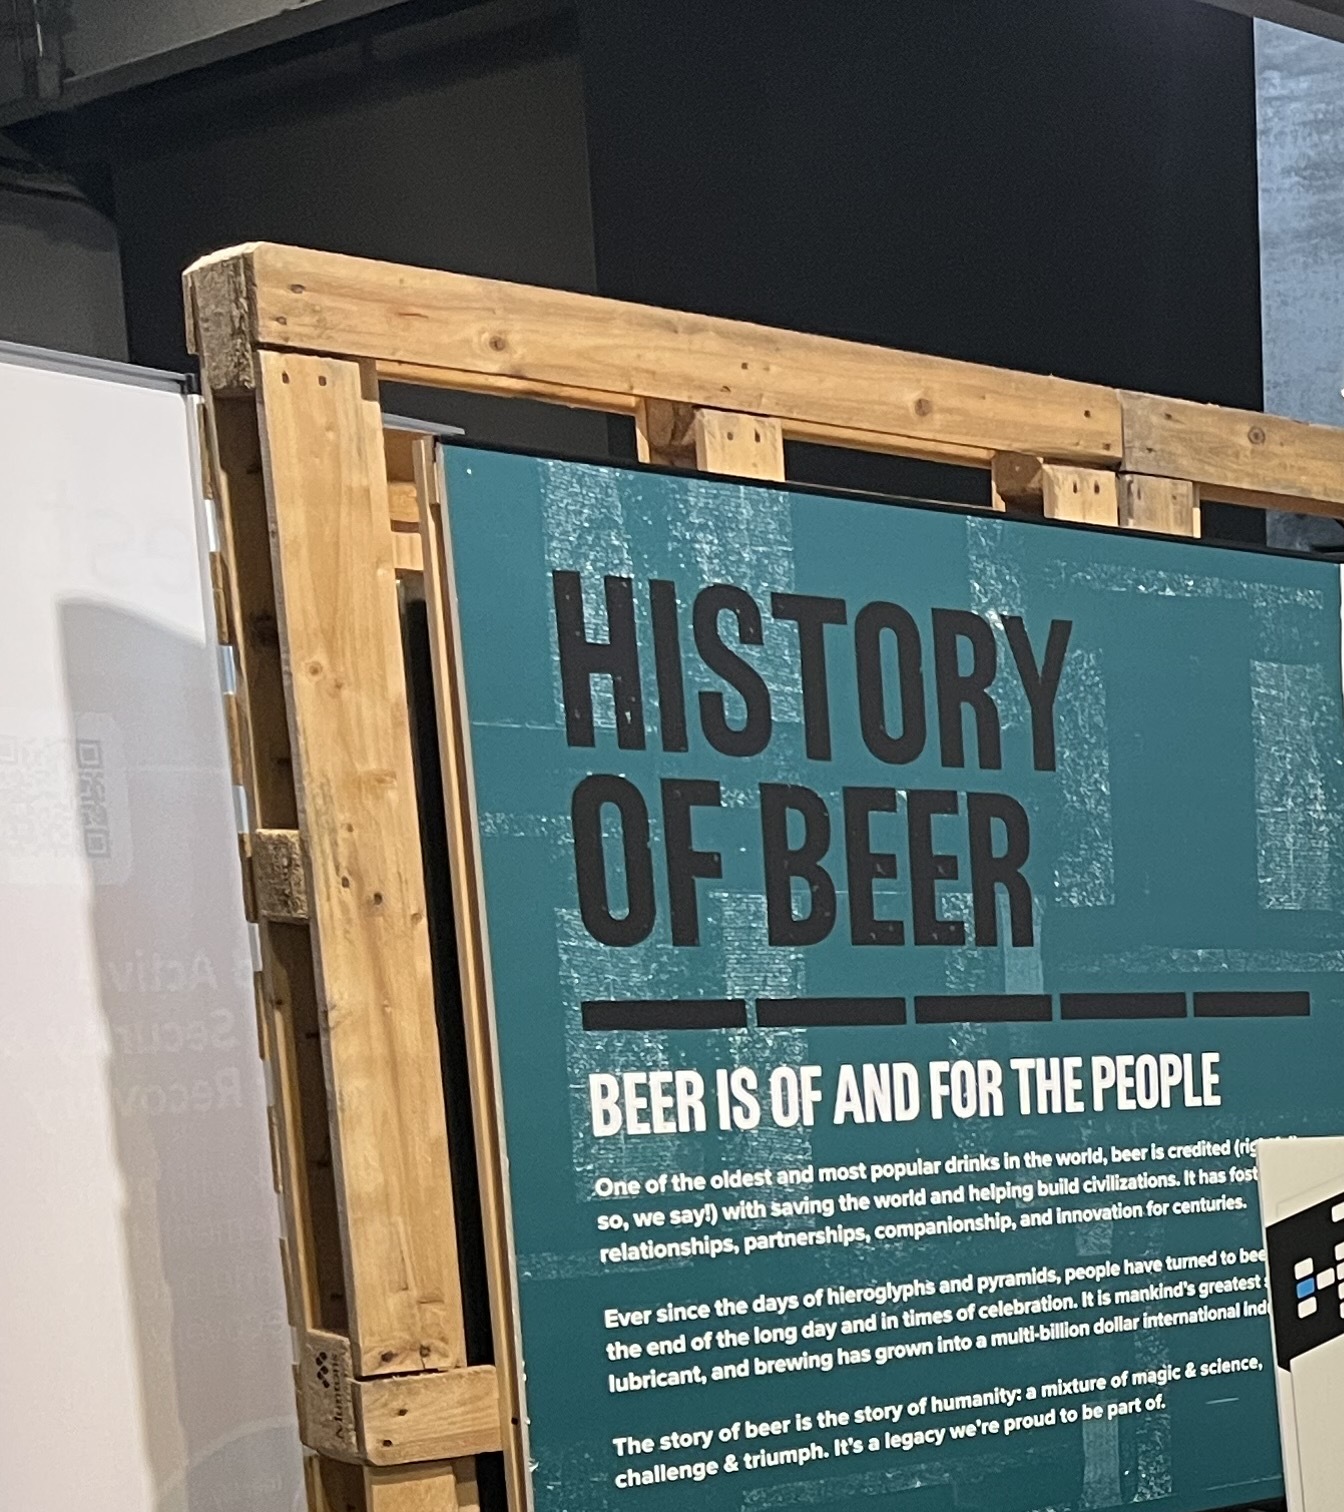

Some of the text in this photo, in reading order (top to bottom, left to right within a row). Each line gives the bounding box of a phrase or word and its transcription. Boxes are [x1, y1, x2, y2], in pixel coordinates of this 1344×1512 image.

[551, 568, 1073, 772] HISTORY
[570, 773, 1034, 948] OF BEER
[588, 1052, 1221, 1137] BEER IS OF AND FOR THE PEOPLE
[599, 1195, 1247, 1265] relationships, partnerships, companionship, and innovation for centuries.
[611, 1356, 1263, 1457] The story of beer is the story of humanity: a mixture of magic & science,
[614, 1396, 1166, 1489] challenge & triumph. It's a legacy we're proud to be part of.
